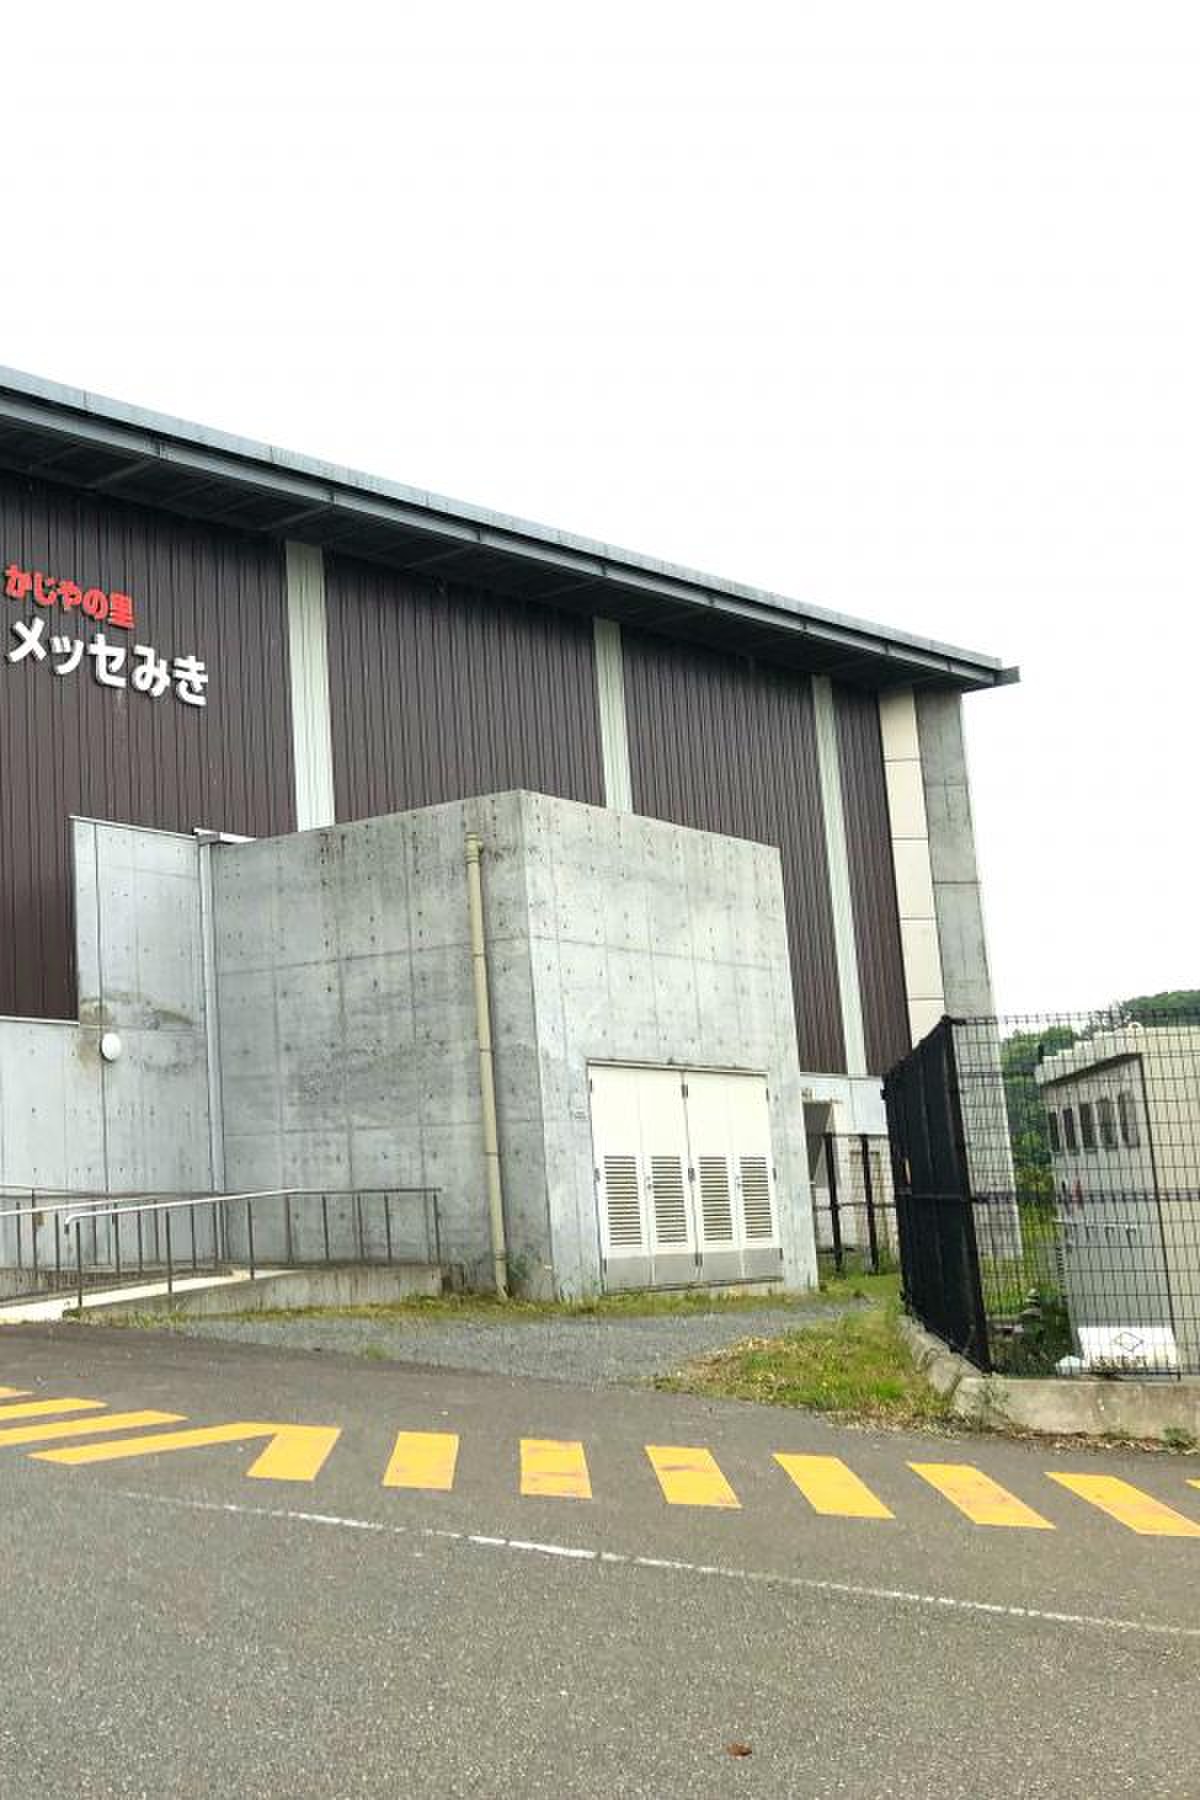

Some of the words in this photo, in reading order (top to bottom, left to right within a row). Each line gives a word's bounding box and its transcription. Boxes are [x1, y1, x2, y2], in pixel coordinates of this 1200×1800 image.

[5, 564, 135, 629] かじやの里
[8, 617, 209, 706] メッセみき
